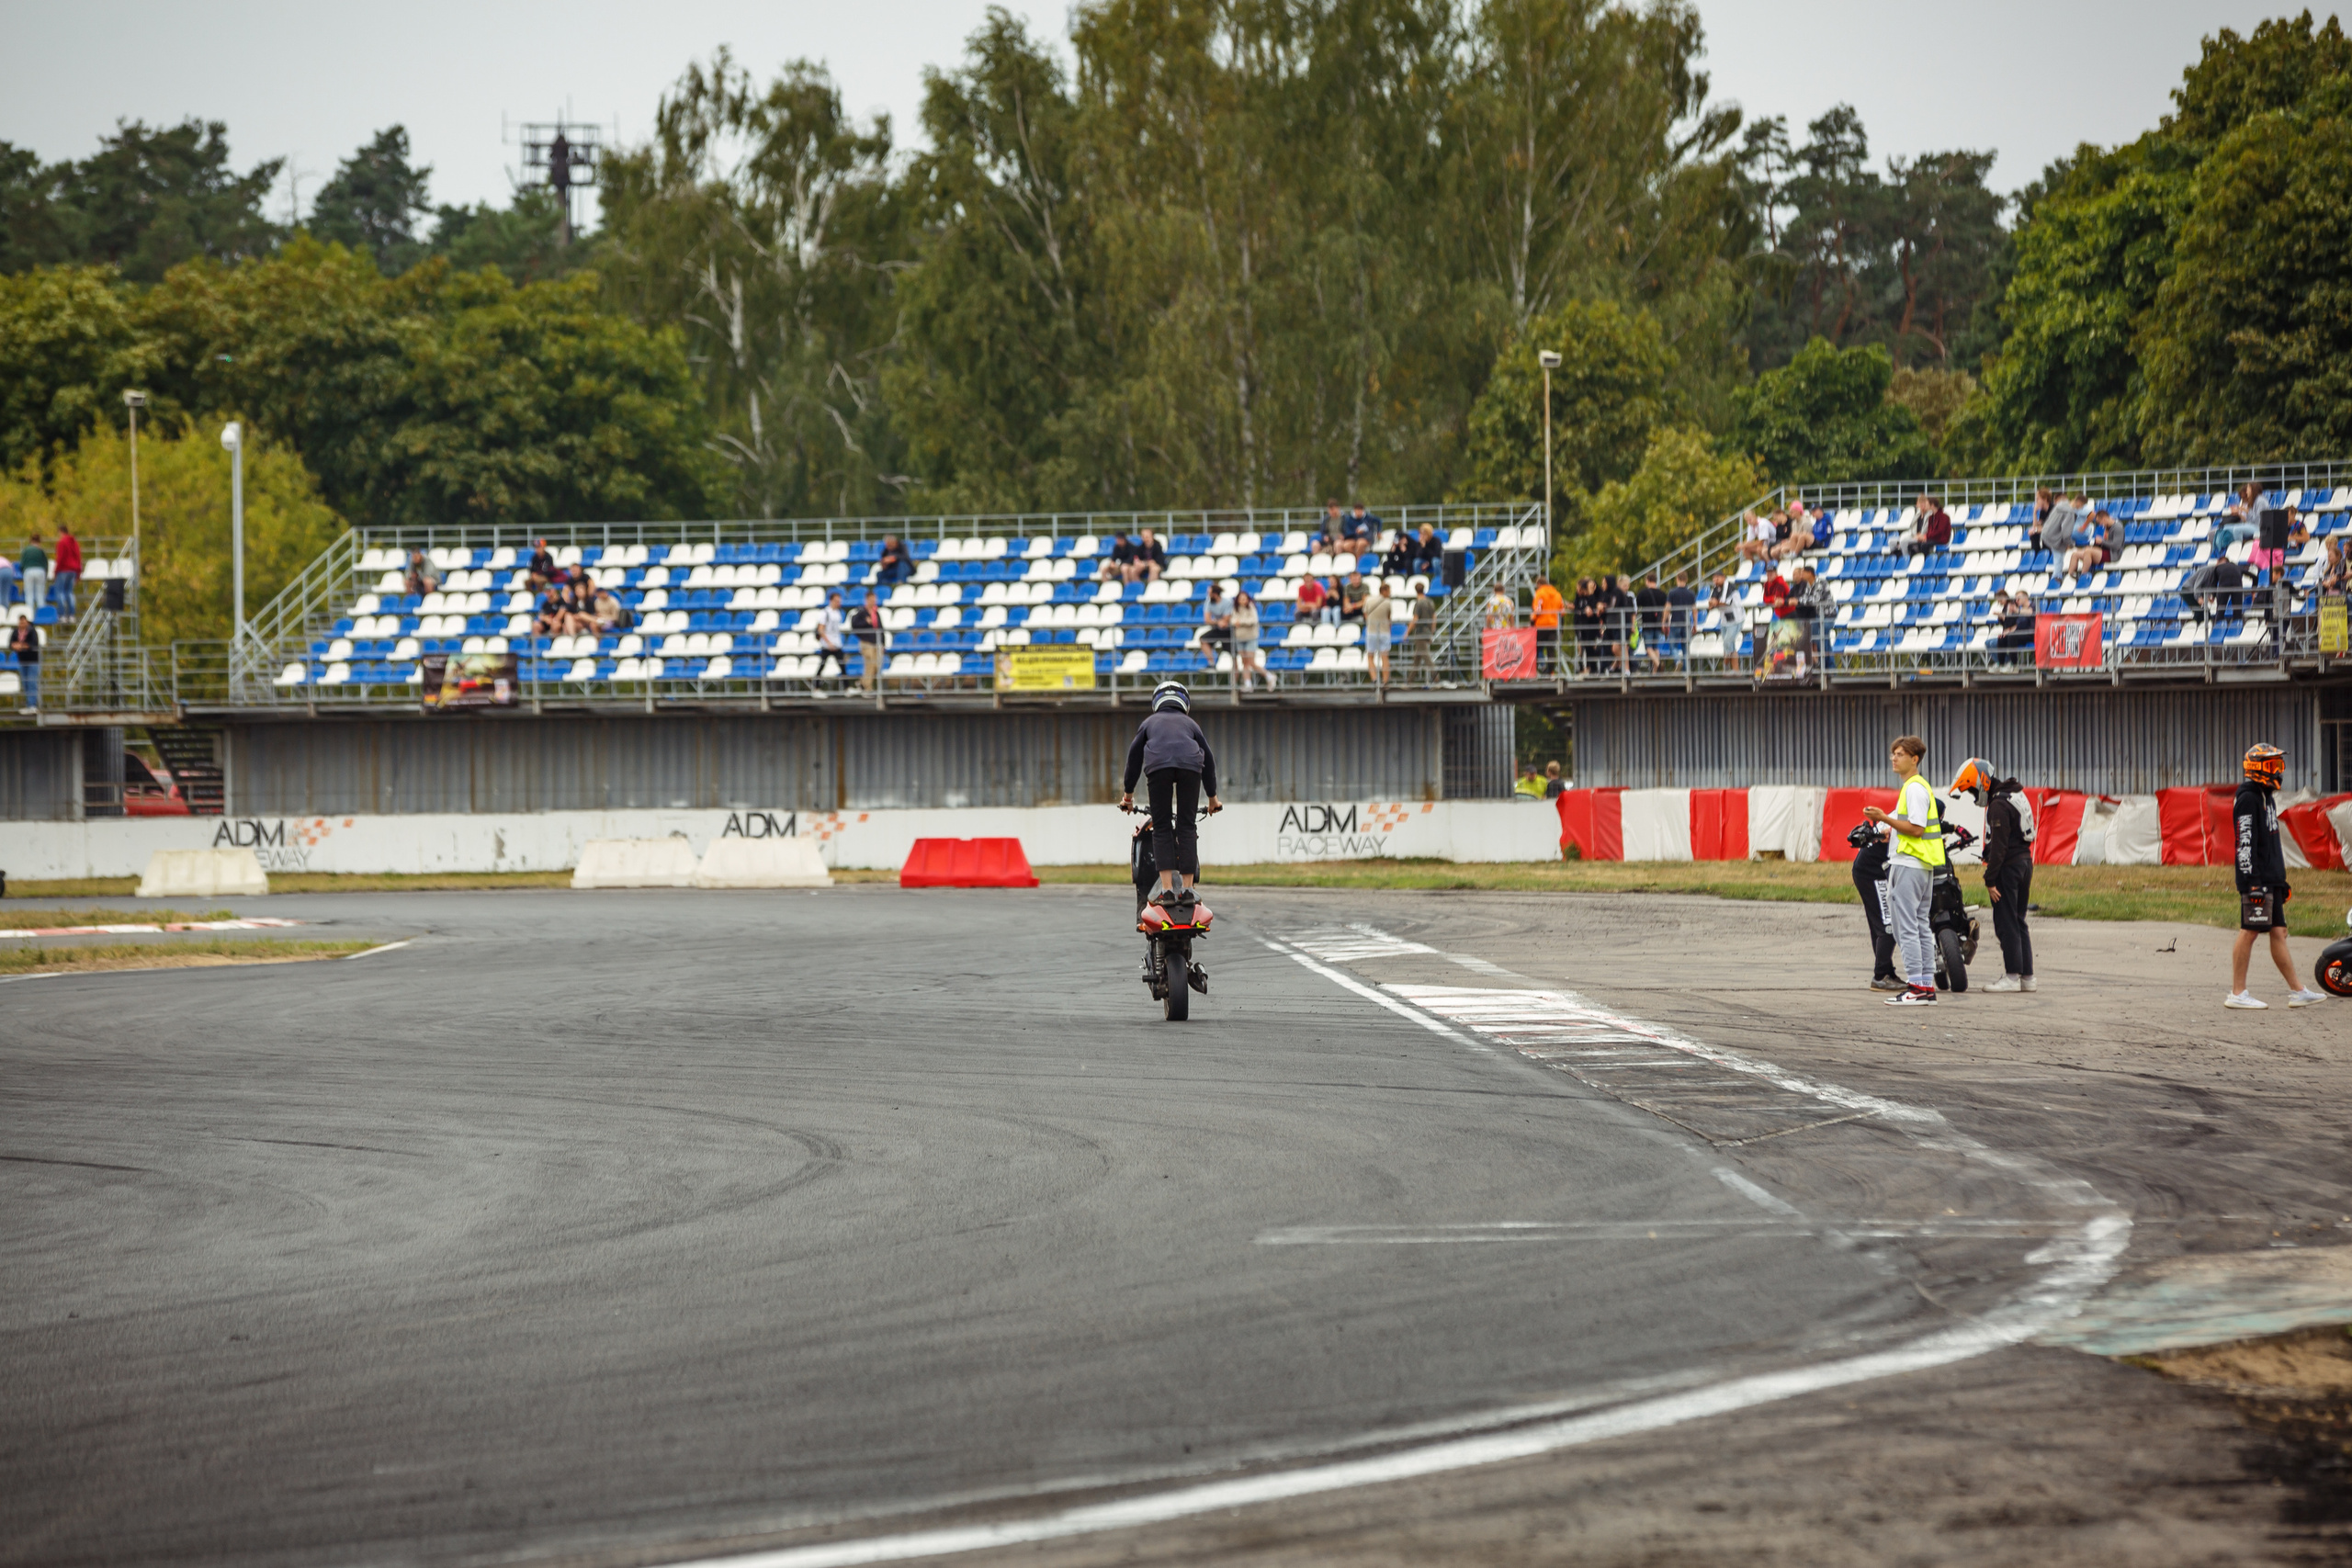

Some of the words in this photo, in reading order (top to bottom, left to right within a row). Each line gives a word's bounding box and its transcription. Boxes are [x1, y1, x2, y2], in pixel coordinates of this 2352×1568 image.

[722, 813, 797, 838] ADM
[1279, 805, 1357, 833] ADM
[212, 820, 285, 847] ADM
[1277, 836, 1388, 855] RACEWAY
[254, 849, 312, 869] EWAY
